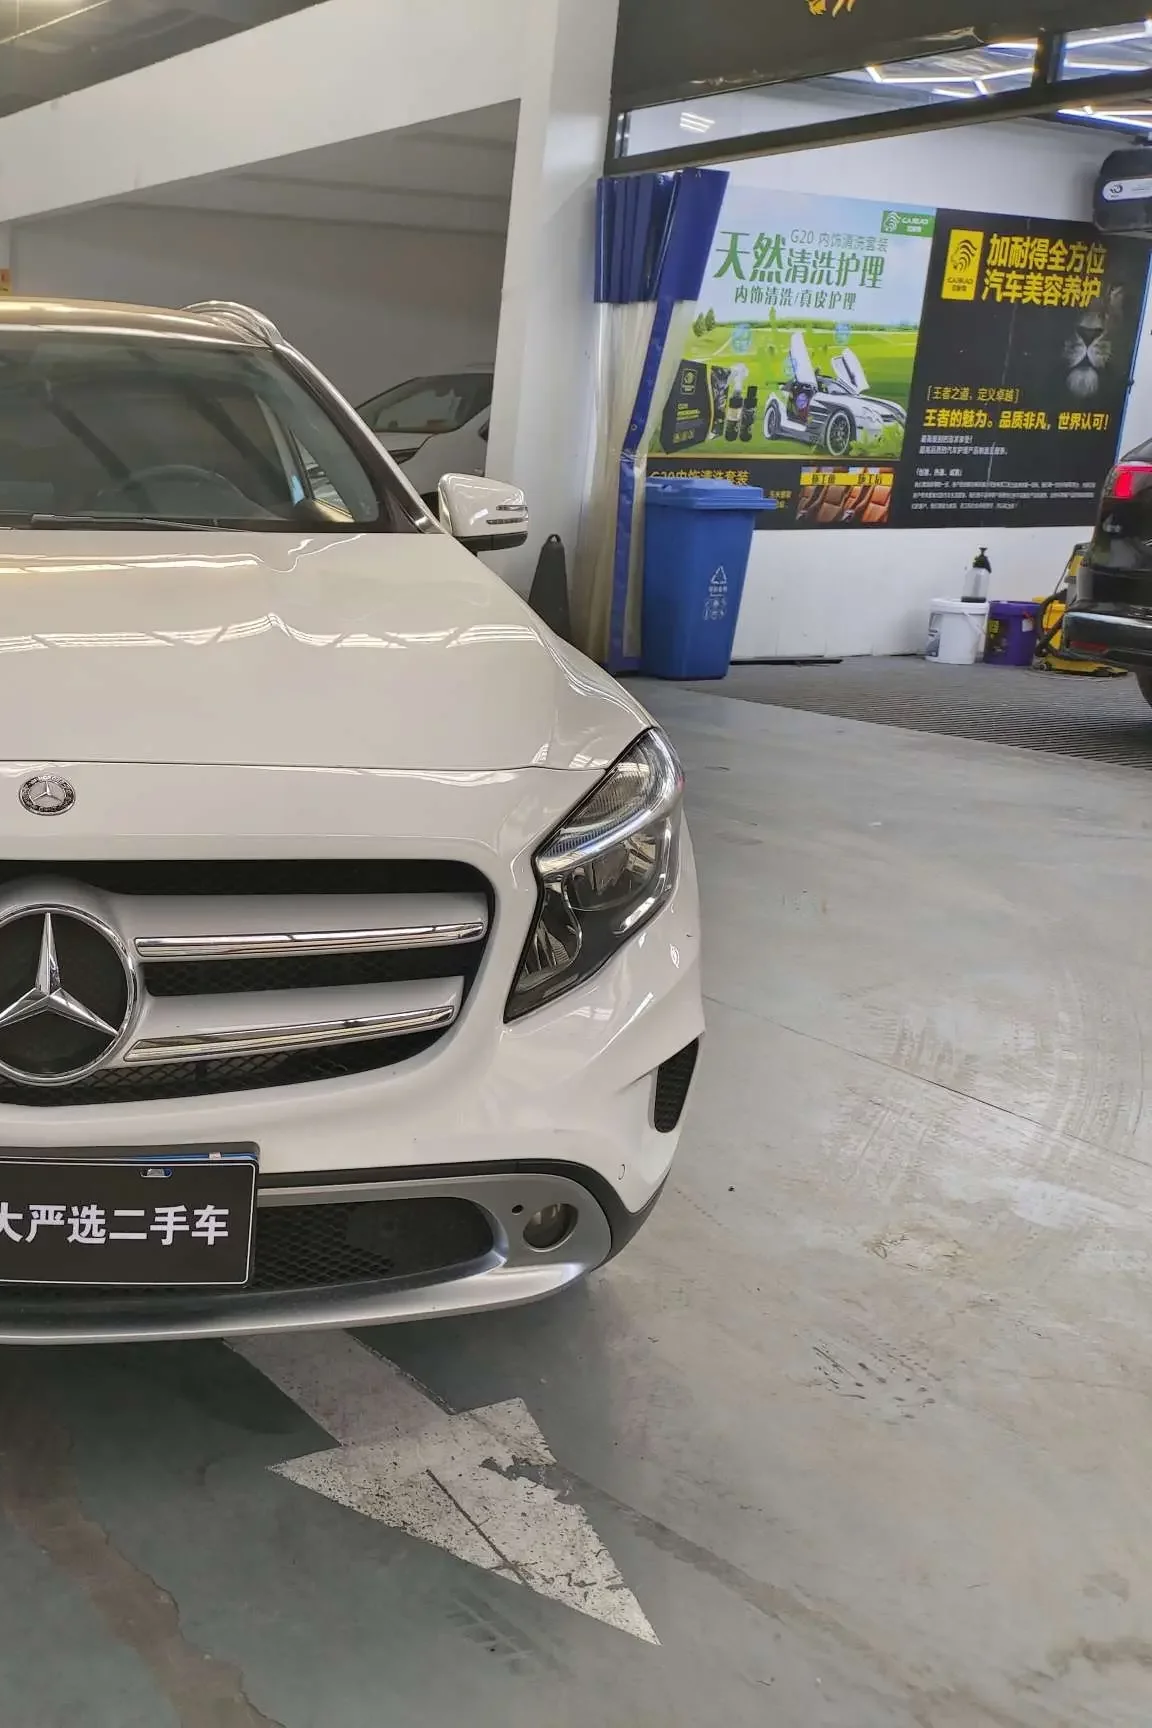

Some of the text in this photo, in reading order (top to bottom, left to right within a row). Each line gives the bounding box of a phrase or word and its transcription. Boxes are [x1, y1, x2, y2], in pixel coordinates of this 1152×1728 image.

[790, 229, 815, 245] G20
[986, 233, 1107, 274] 加耐得全方位
[734, 285, 857, 310] 内饰清洗/真皮护理
[981, 269, 1102, 308] 汽车美容养护
